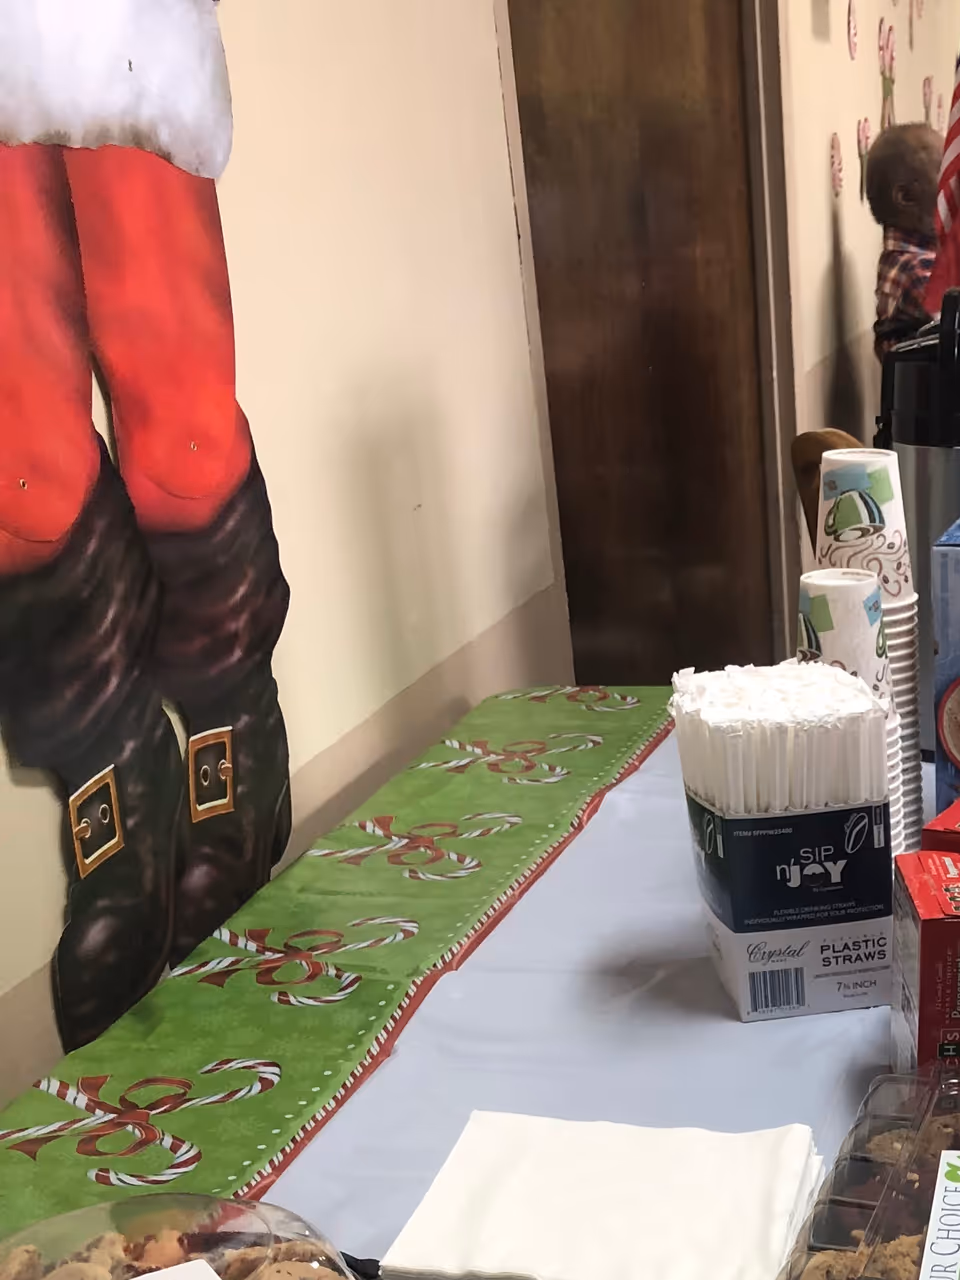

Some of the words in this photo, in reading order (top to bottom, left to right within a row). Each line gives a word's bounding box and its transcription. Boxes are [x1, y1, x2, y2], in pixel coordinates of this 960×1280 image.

[799, 845, 834, 864] SIP
[746, 939, 811, 967] Crystal
[820, 936, 888, 955] PLASTIC
[821, 949, 887, 968] STRAWS
[852, 979, 878, 991] INCH
